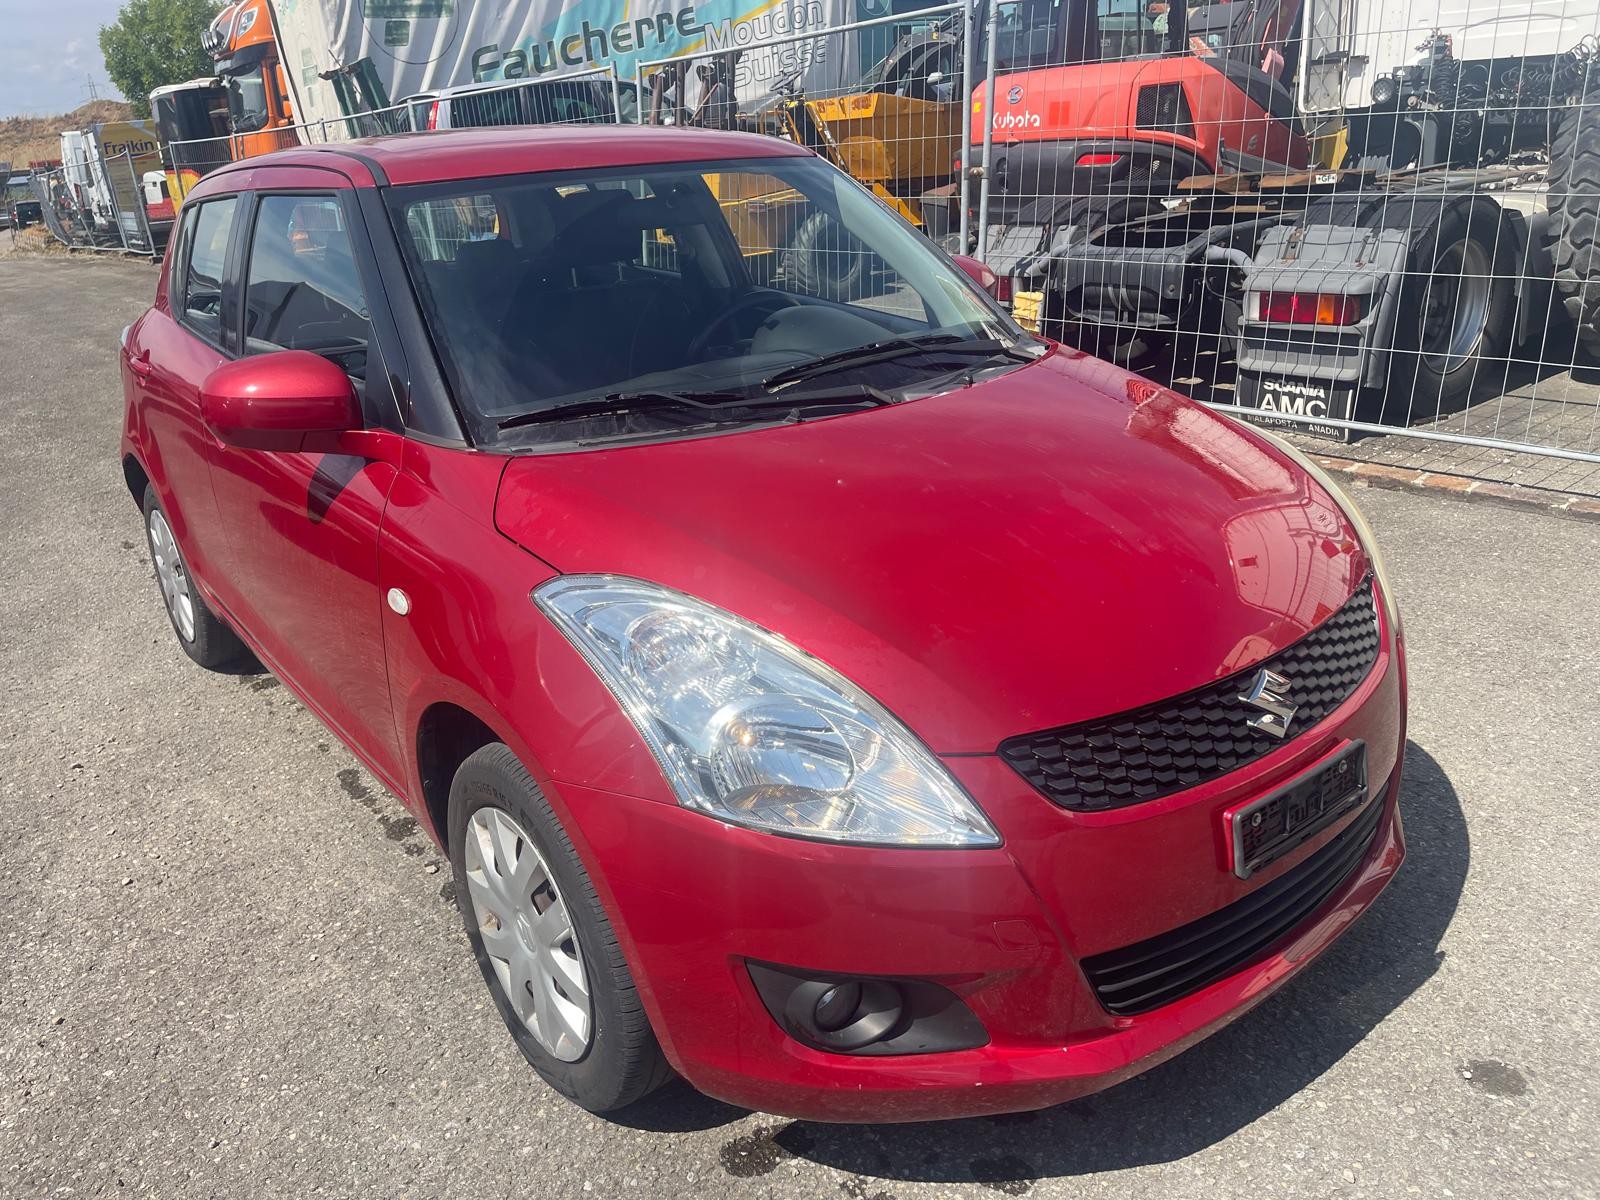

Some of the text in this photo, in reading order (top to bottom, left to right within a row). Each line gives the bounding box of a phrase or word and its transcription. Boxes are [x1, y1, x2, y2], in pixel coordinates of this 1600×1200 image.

[472, 7, 706, 82] Faucherre
[704, 1, 824, 52] Moudon
[733, 37, 825, 88] Suisse
[1260, 393, 1327, 418] AMC
[1263, 378, 1326, 399] SCANIA
[1308, 423, 1340, 437] ANADIA
